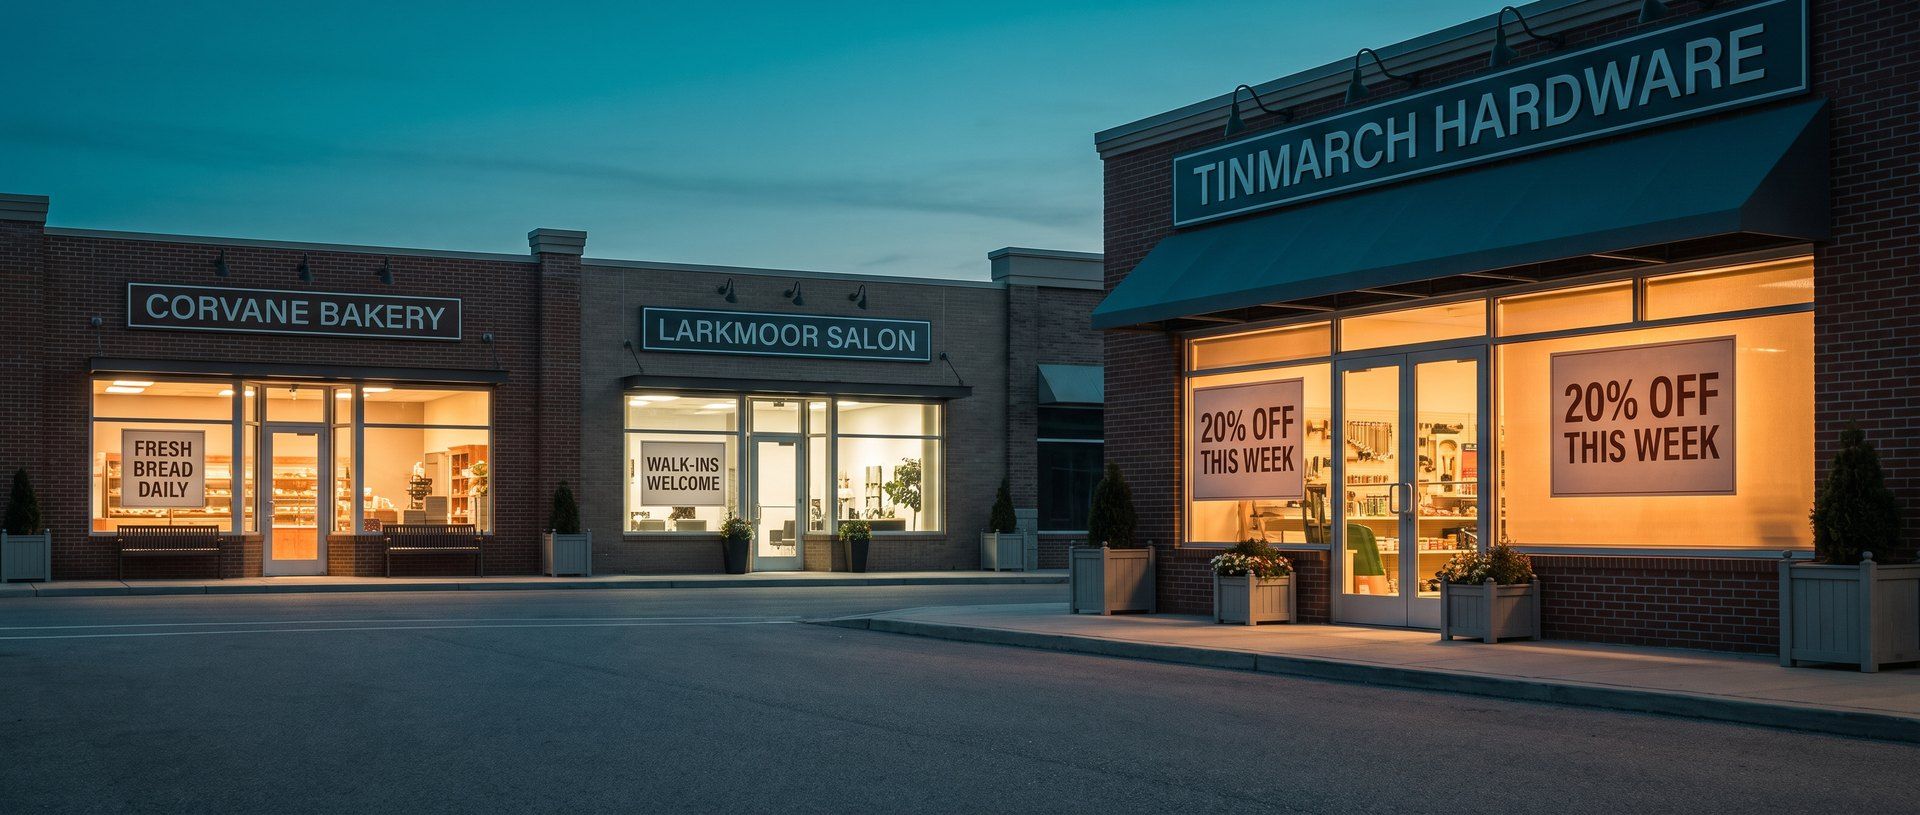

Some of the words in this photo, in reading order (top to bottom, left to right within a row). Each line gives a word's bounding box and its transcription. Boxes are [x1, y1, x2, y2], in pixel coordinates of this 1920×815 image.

[1193, 112, 1417, 206] TINMARCH
[1435, 23, 1766, 152] HARDWARE
[146, 294, 309, 325] CORVANE
[320, 302, 445, 330] BAKERY
[659, 318, 818, 347] LARKMOOR
[827, 326, 915, 351] SALON
[1564, 377, 1639, 423] 20%
[1649, 371, 1720, 420] OFF
[1200, 409, 1246, 443] 20%
[1252, 405, 1295, 441] OFF
[135, 440, 192, 457] FRESH
[1200, 447, 1239, 475] THIS
[1243, 445, 1295, 474] WEEK
[1564, 428, 1626, 465] THIS
[1634, 424, 1720, 462] WEEK
[134, 461, 193, 477] BREAD
[646, 456, 719, 472] WALK-INS
[139, 482, 189, 498] DAILY
[647, 475, 720, 491] WELCOME
